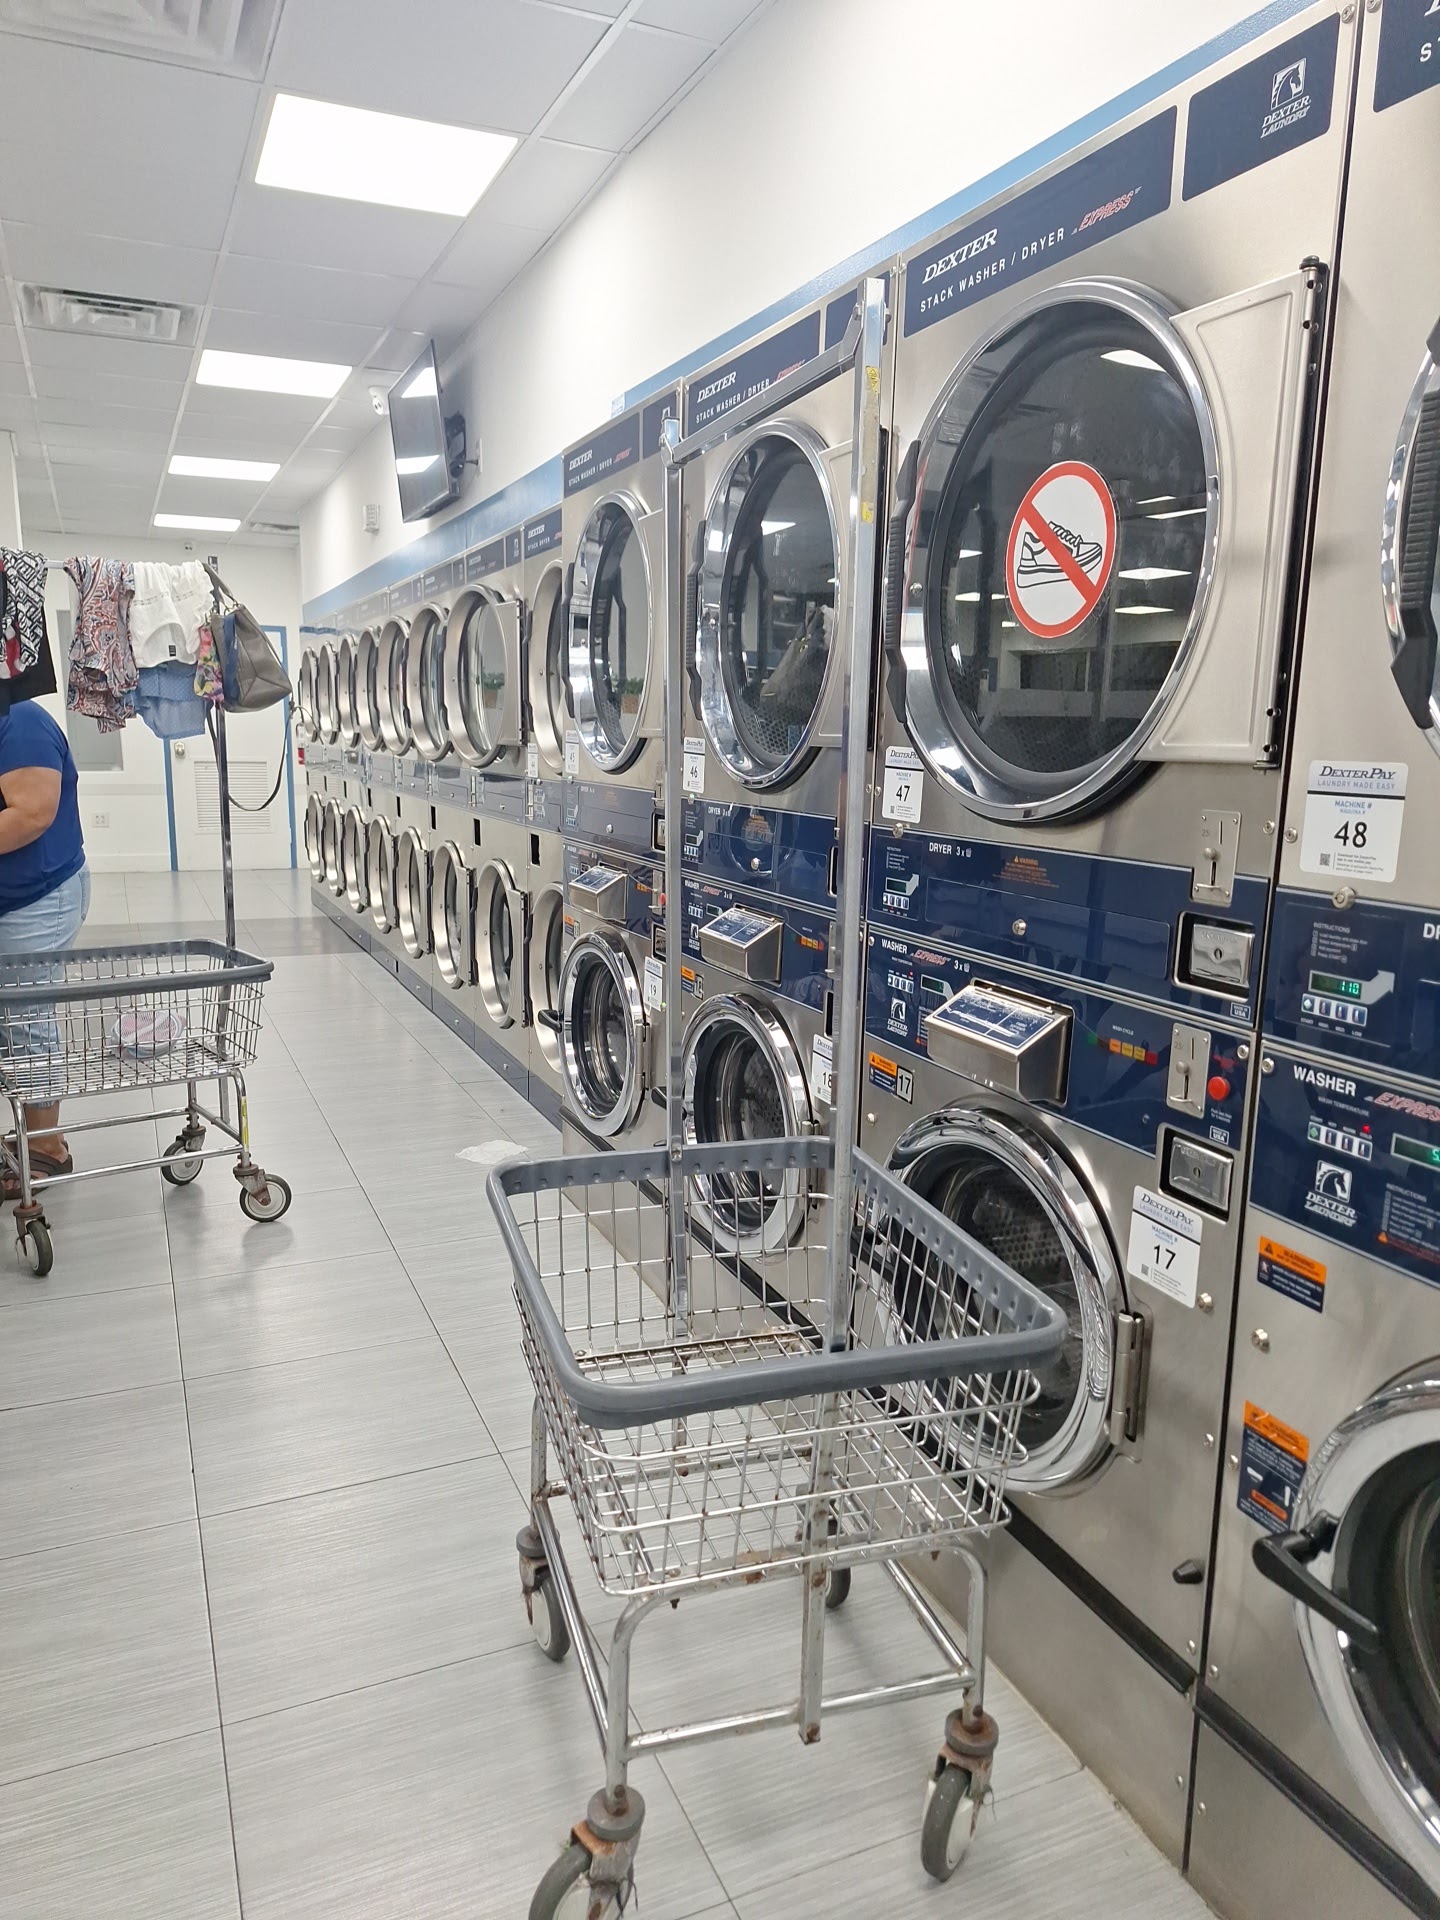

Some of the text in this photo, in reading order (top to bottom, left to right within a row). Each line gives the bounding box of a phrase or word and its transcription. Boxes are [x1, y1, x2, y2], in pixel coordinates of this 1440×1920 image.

[1260, 105, 1311, 138] LAUNDRY
[1262, 95, 1310, 128] DEXTER
[920, 191, 1134, 313] STACK WASHER / DRYER EXPRESS
[922, 228, 998, 284] DEXTER
[697, 371, 737, 404] DEXTER
[696, 408, 714, 424] STACK
[716, 394, 741, 413] WASHER
[748, 378, 770, 396] DRYER
[569, 449, 593, 471] DEXTER
[690, 765, 698, 779] 46
[896, 785, 910, 802] 47
[1317, 779, 1395, 790] LAUNDRY MADE EASY
[1335, 800, 1365, 809] MACHINE
[1334, 821, 1367, 848] 48
[929, 842, 952, 855] DRYER
[882, 938, 907, 954] WASHER
[650, 983, 657, 996] 19
[1234, 1009, 1246, 1017] USA
[899, 1074, 911, 1094] 17
[1294, 1065, 1440, 1122] WASHER EXPRES
[1213, 1132, 1225, 1142] USA
[1304, 1201, 1357, 1227] LAUNDRY
[1305, 1191, 1358, 1219] DEXTER
[1151, 1224, 1174, 1241] MACHINE
[1165, 1215, 1178, 1226] MADE
[1180, 1221, 1193, 1233] EASY
[1154, 1244, 1176, 1270] 17
